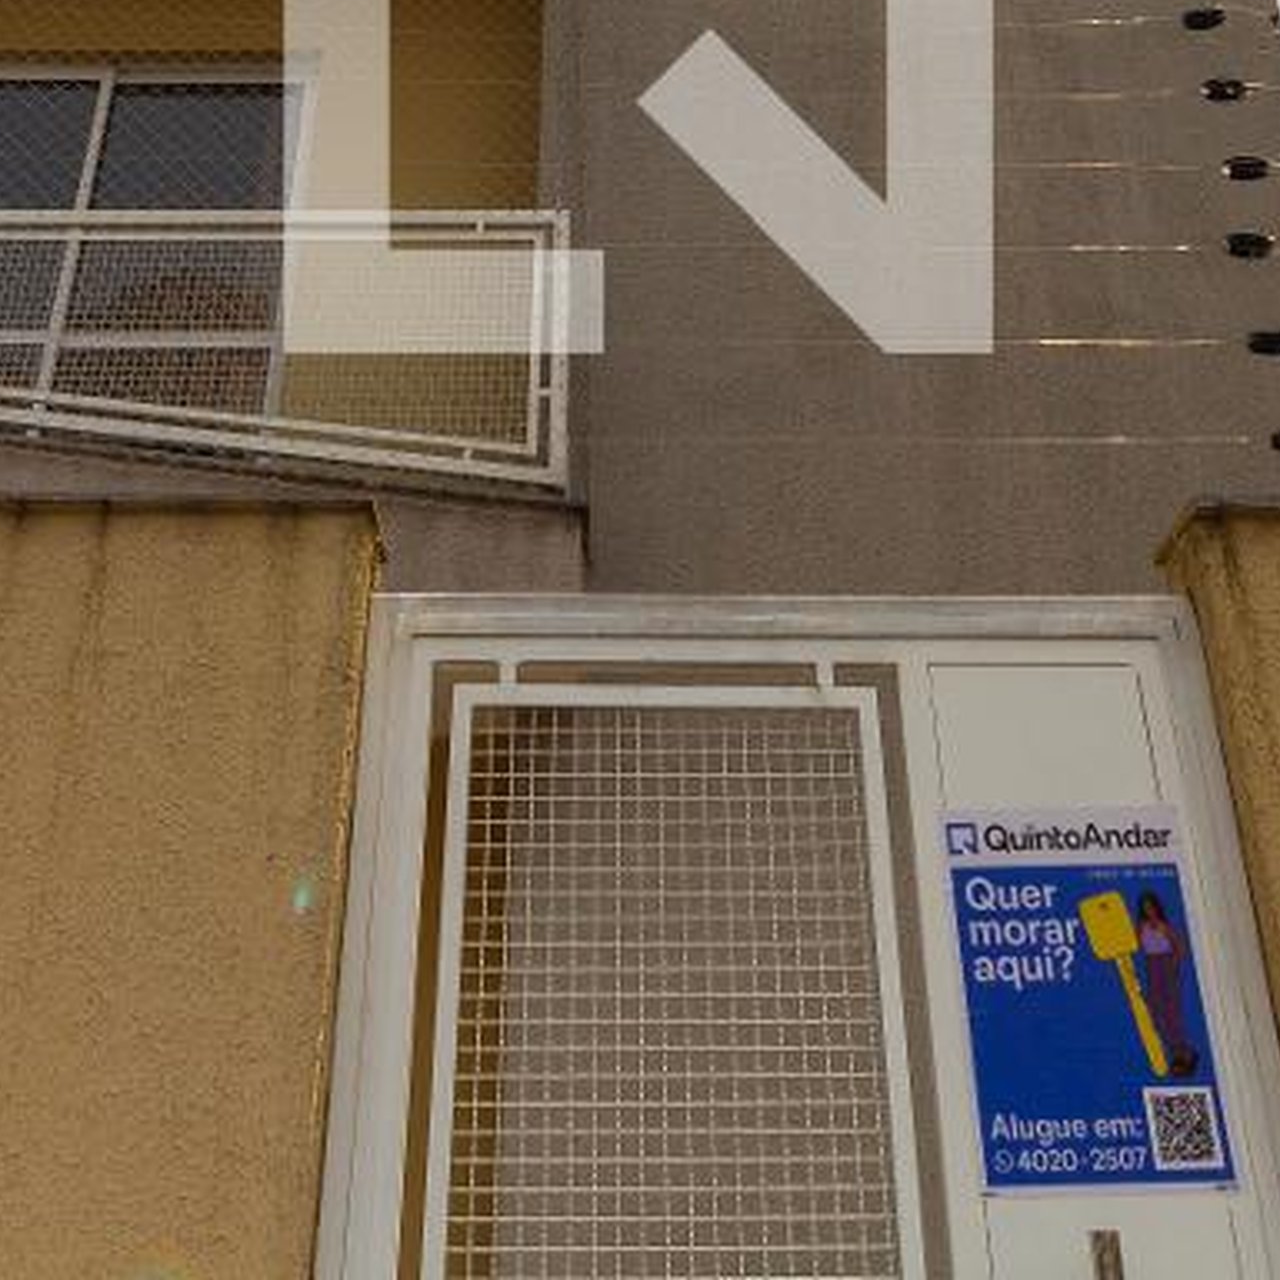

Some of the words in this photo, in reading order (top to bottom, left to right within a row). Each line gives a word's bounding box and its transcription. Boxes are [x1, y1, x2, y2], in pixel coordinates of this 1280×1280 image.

[983, 823, 1171, 853] QuintoAndar
[965, 877, 1056, 911] Quer
[969, 918, 1079, 945] morar
[973, 947, 1073, 990] aqui?
[991, 1113, 1086, 1146] Alugue
[1094, 1117, 1144, 1138] em:
